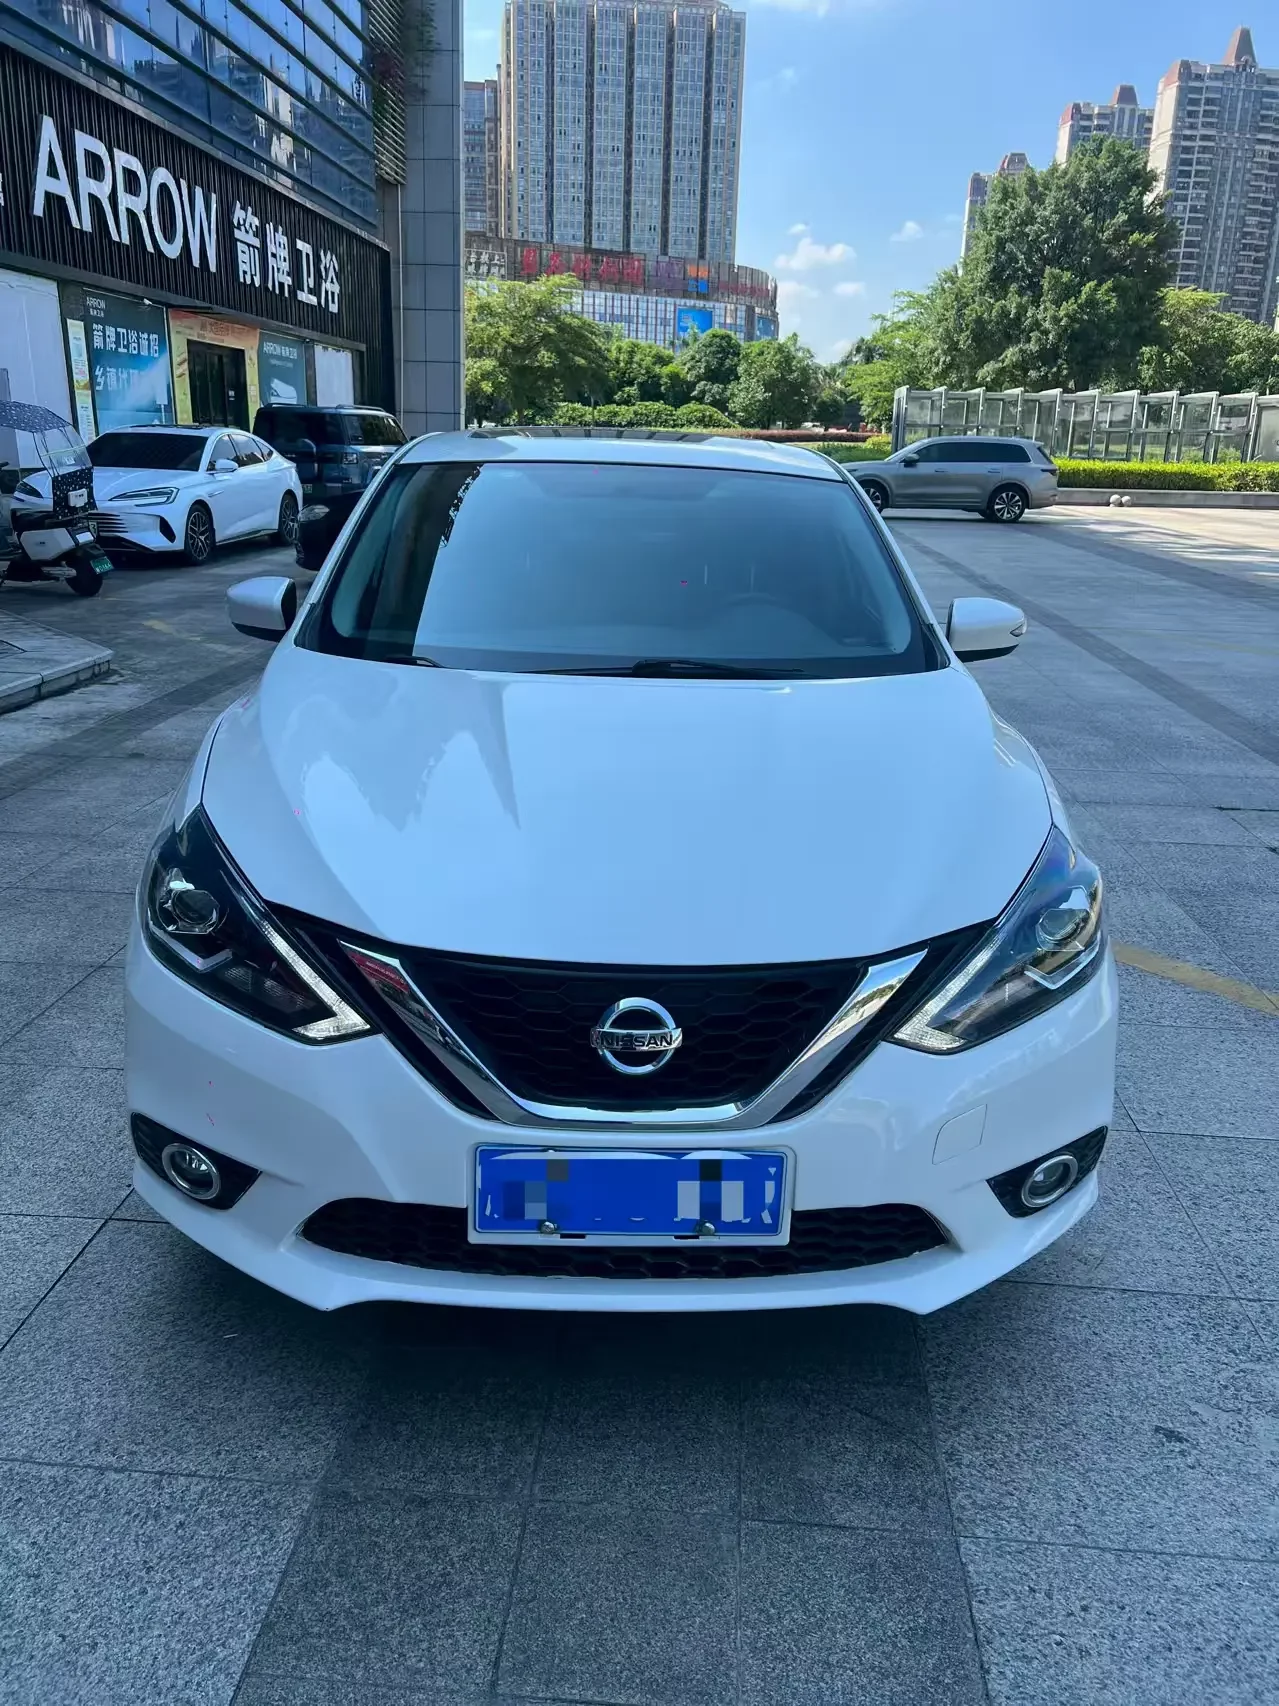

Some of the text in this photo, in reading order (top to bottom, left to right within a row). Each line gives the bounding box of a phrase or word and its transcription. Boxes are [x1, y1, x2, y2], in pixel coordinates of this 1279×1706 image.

[33, 114, 217, 272] ARROW
[232, 201, 341, 314] 箭牌卫浴
[86, 296, 106, 310] ARROW
[92, 323, 159, 358] 箭牌卫浴诚招
[600, 1033, 673, 1047] NISSAN
